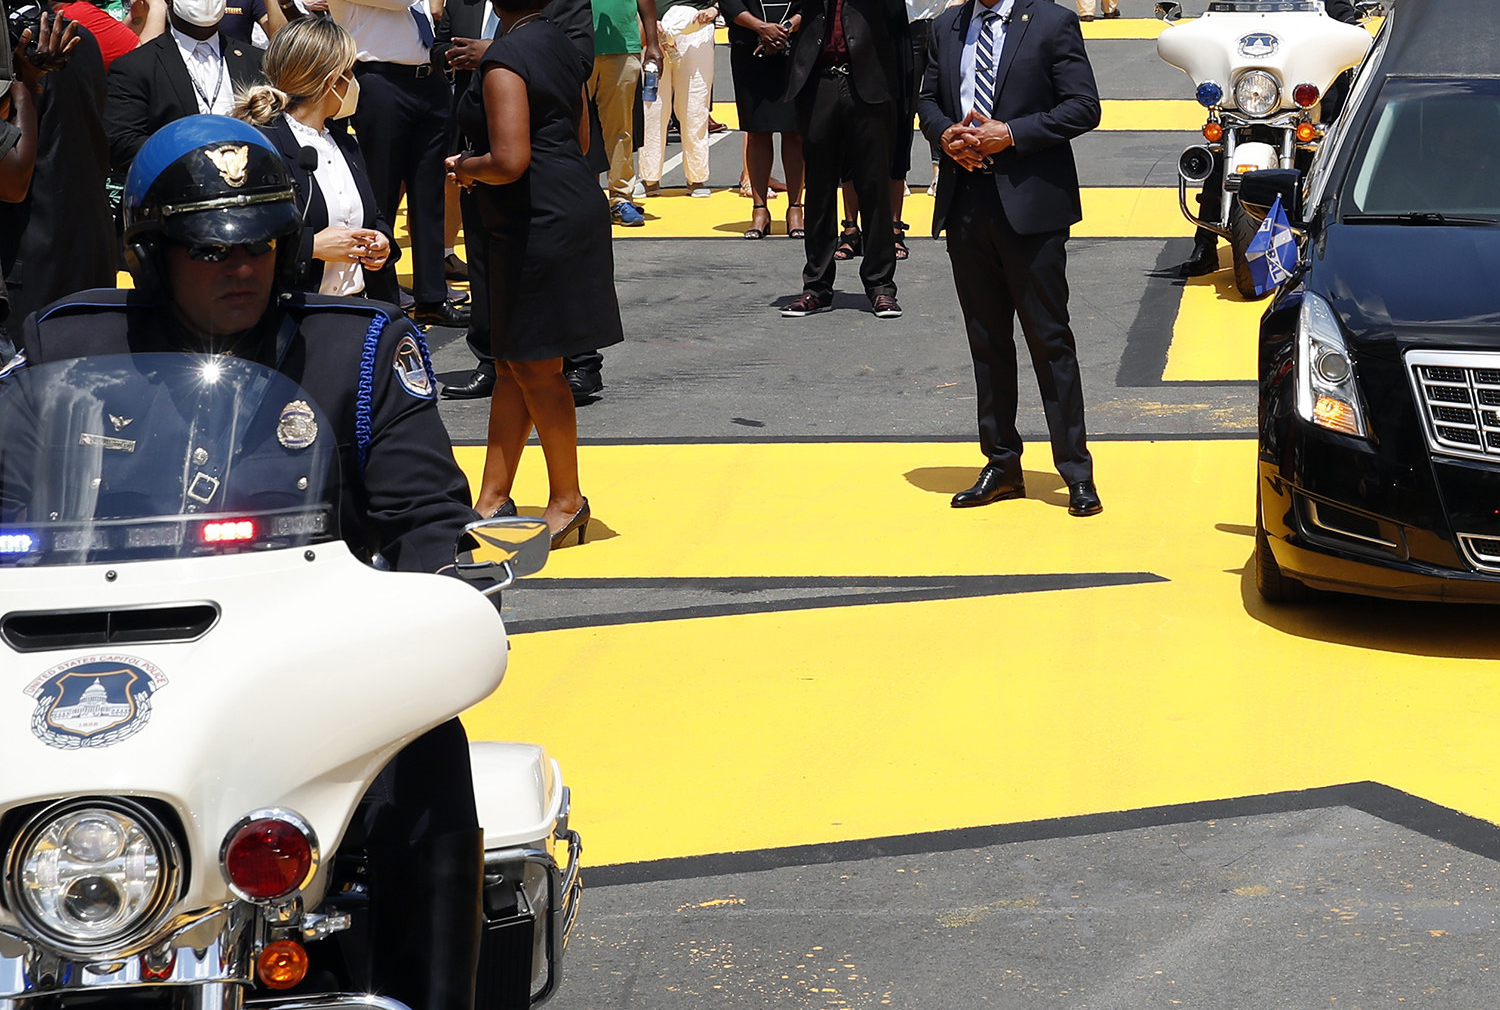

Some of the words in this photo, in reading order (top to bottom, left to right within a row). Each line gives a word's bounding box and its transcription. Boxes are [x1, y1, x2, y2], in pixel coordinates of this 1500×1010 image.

[27, 670, 57, 693] UNITED
[57, 657, 96, 671] STATES
[99, 655, 140, 667] CAPITOL
[142, 662, 167, 684] POLICE
